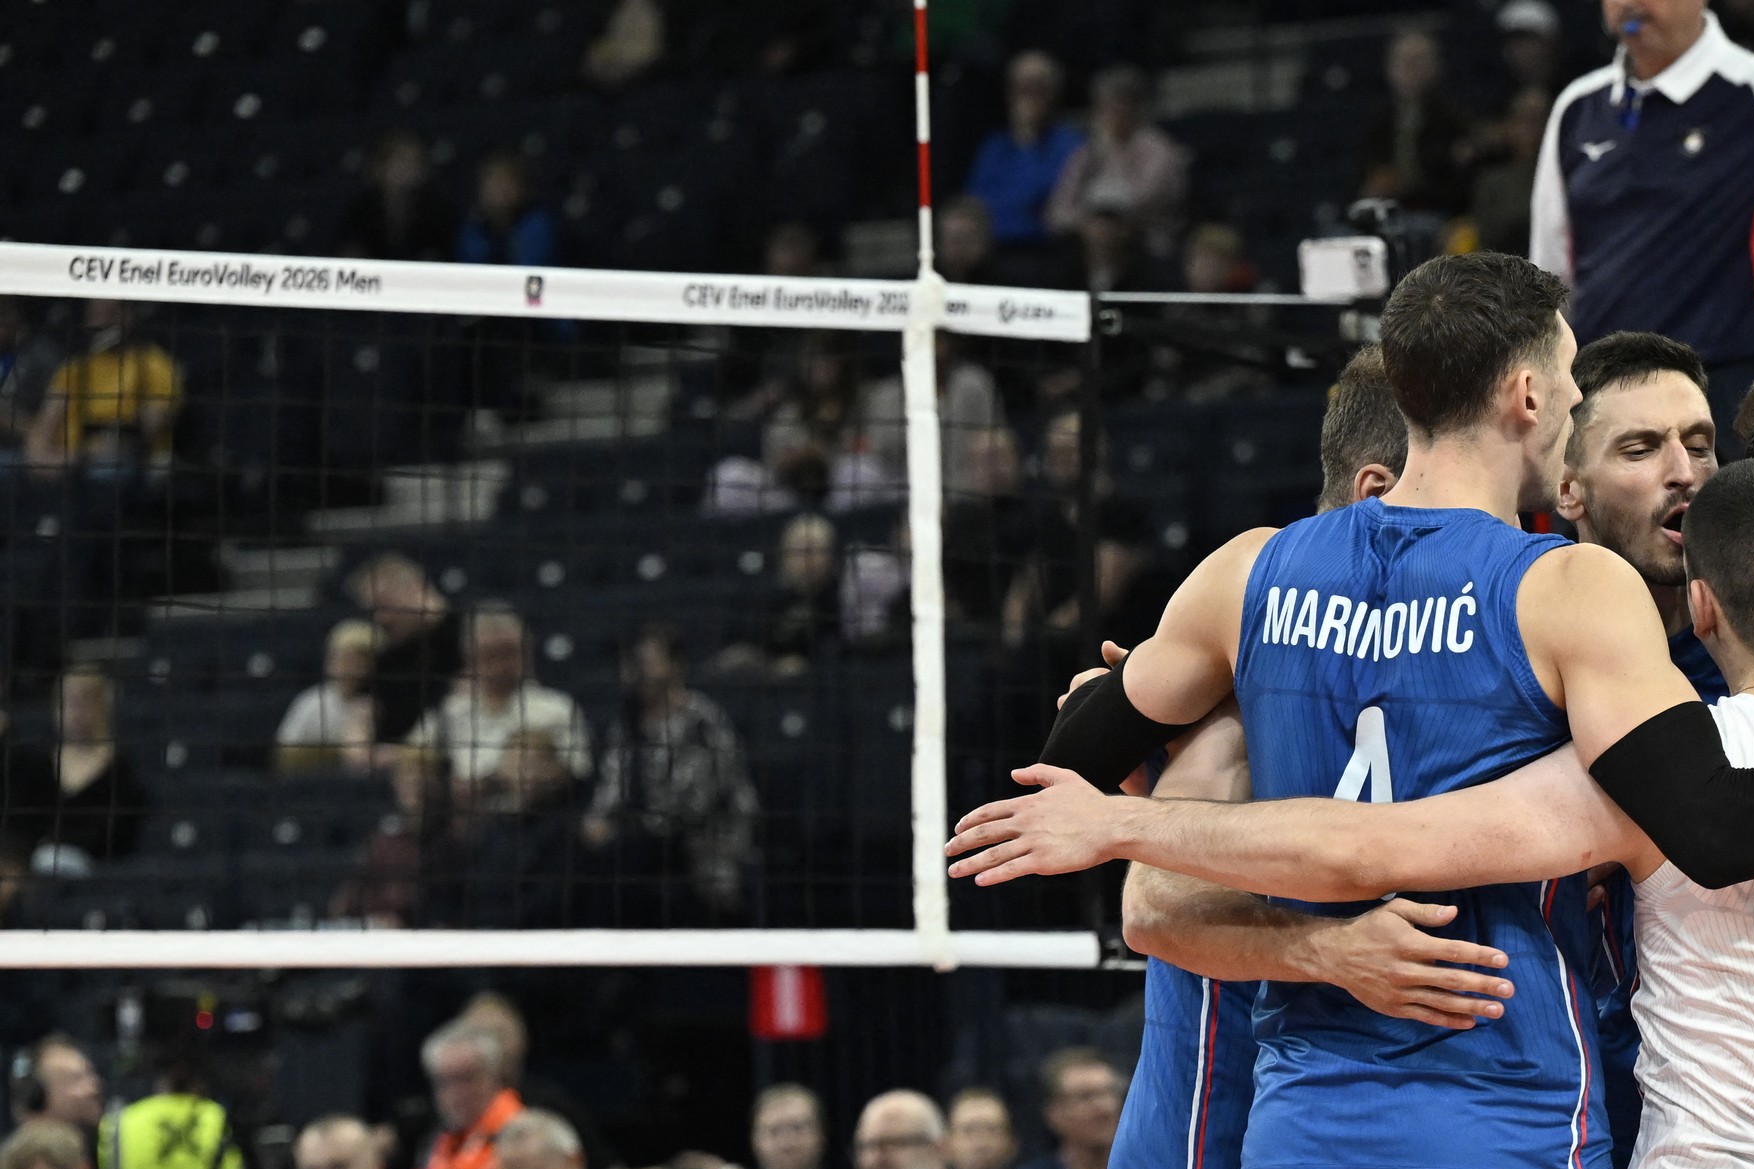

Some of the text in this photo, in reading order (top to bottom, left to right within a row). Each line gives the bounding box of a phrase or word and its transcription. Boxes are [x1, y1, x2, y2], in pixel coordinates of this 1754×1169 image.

[68, 256, 383, 295] CEV Enel EuroVolley 2026 Men
[683, 283, 725, 309] CEV
[728, 285, 767, 310] Enel
[1262, 581, 1477, 663] MARINOVIĆ
